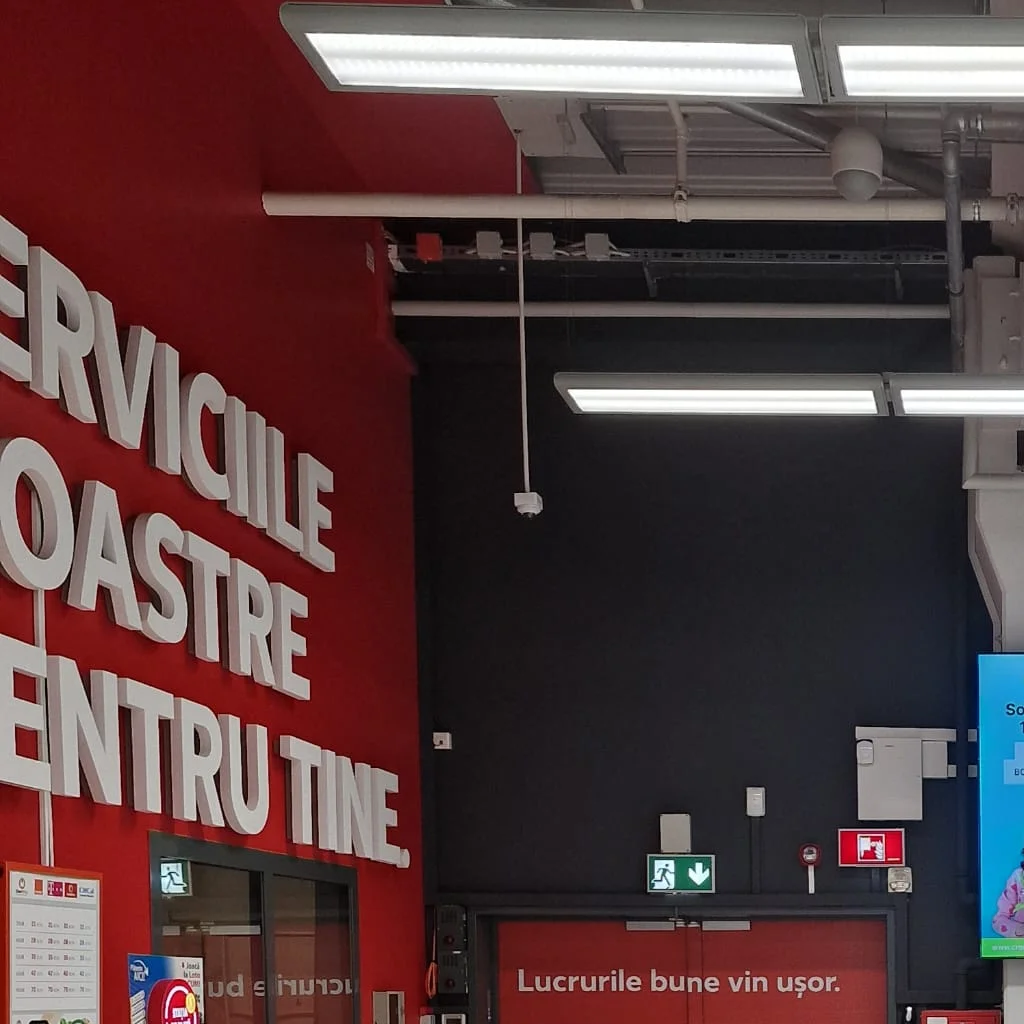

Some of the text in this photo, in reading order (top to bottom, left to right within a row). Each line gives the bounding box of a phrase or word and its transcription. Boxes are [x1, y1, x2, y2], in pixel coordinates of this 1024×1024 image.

[517, 968, 841, 999] Lucrurile bune vin ușor.
